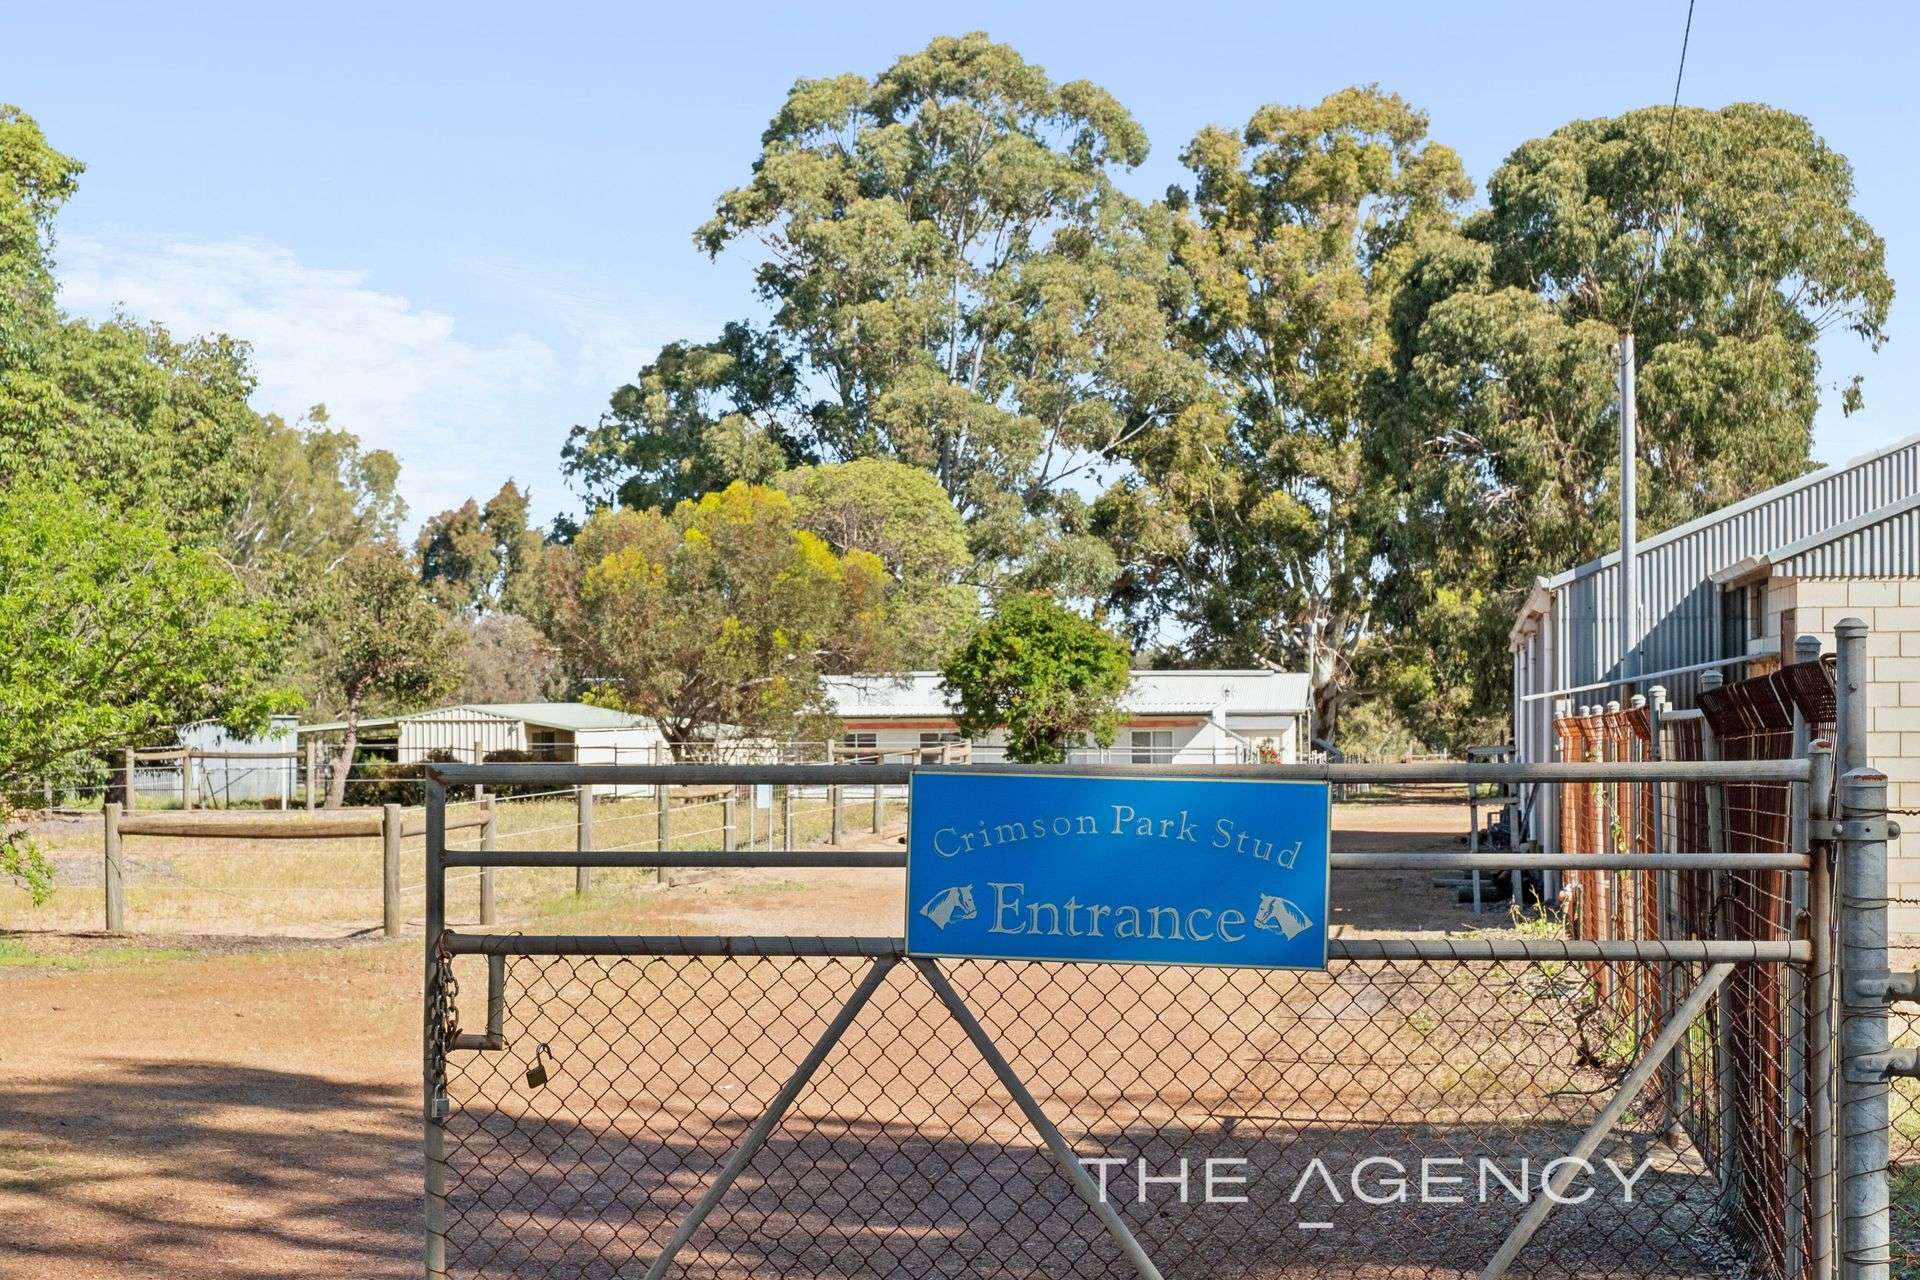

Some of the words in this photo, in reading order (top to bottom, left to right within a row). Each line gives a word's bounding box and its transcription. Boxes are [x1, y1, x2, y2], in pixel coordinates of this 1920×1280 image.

[933, 811, 1099, 858] Crimson
[1110, 804, 1198, 843] Park
[1211, 817, 1302, 871] Stud
[986, 881, 1247, 944] Entrance
